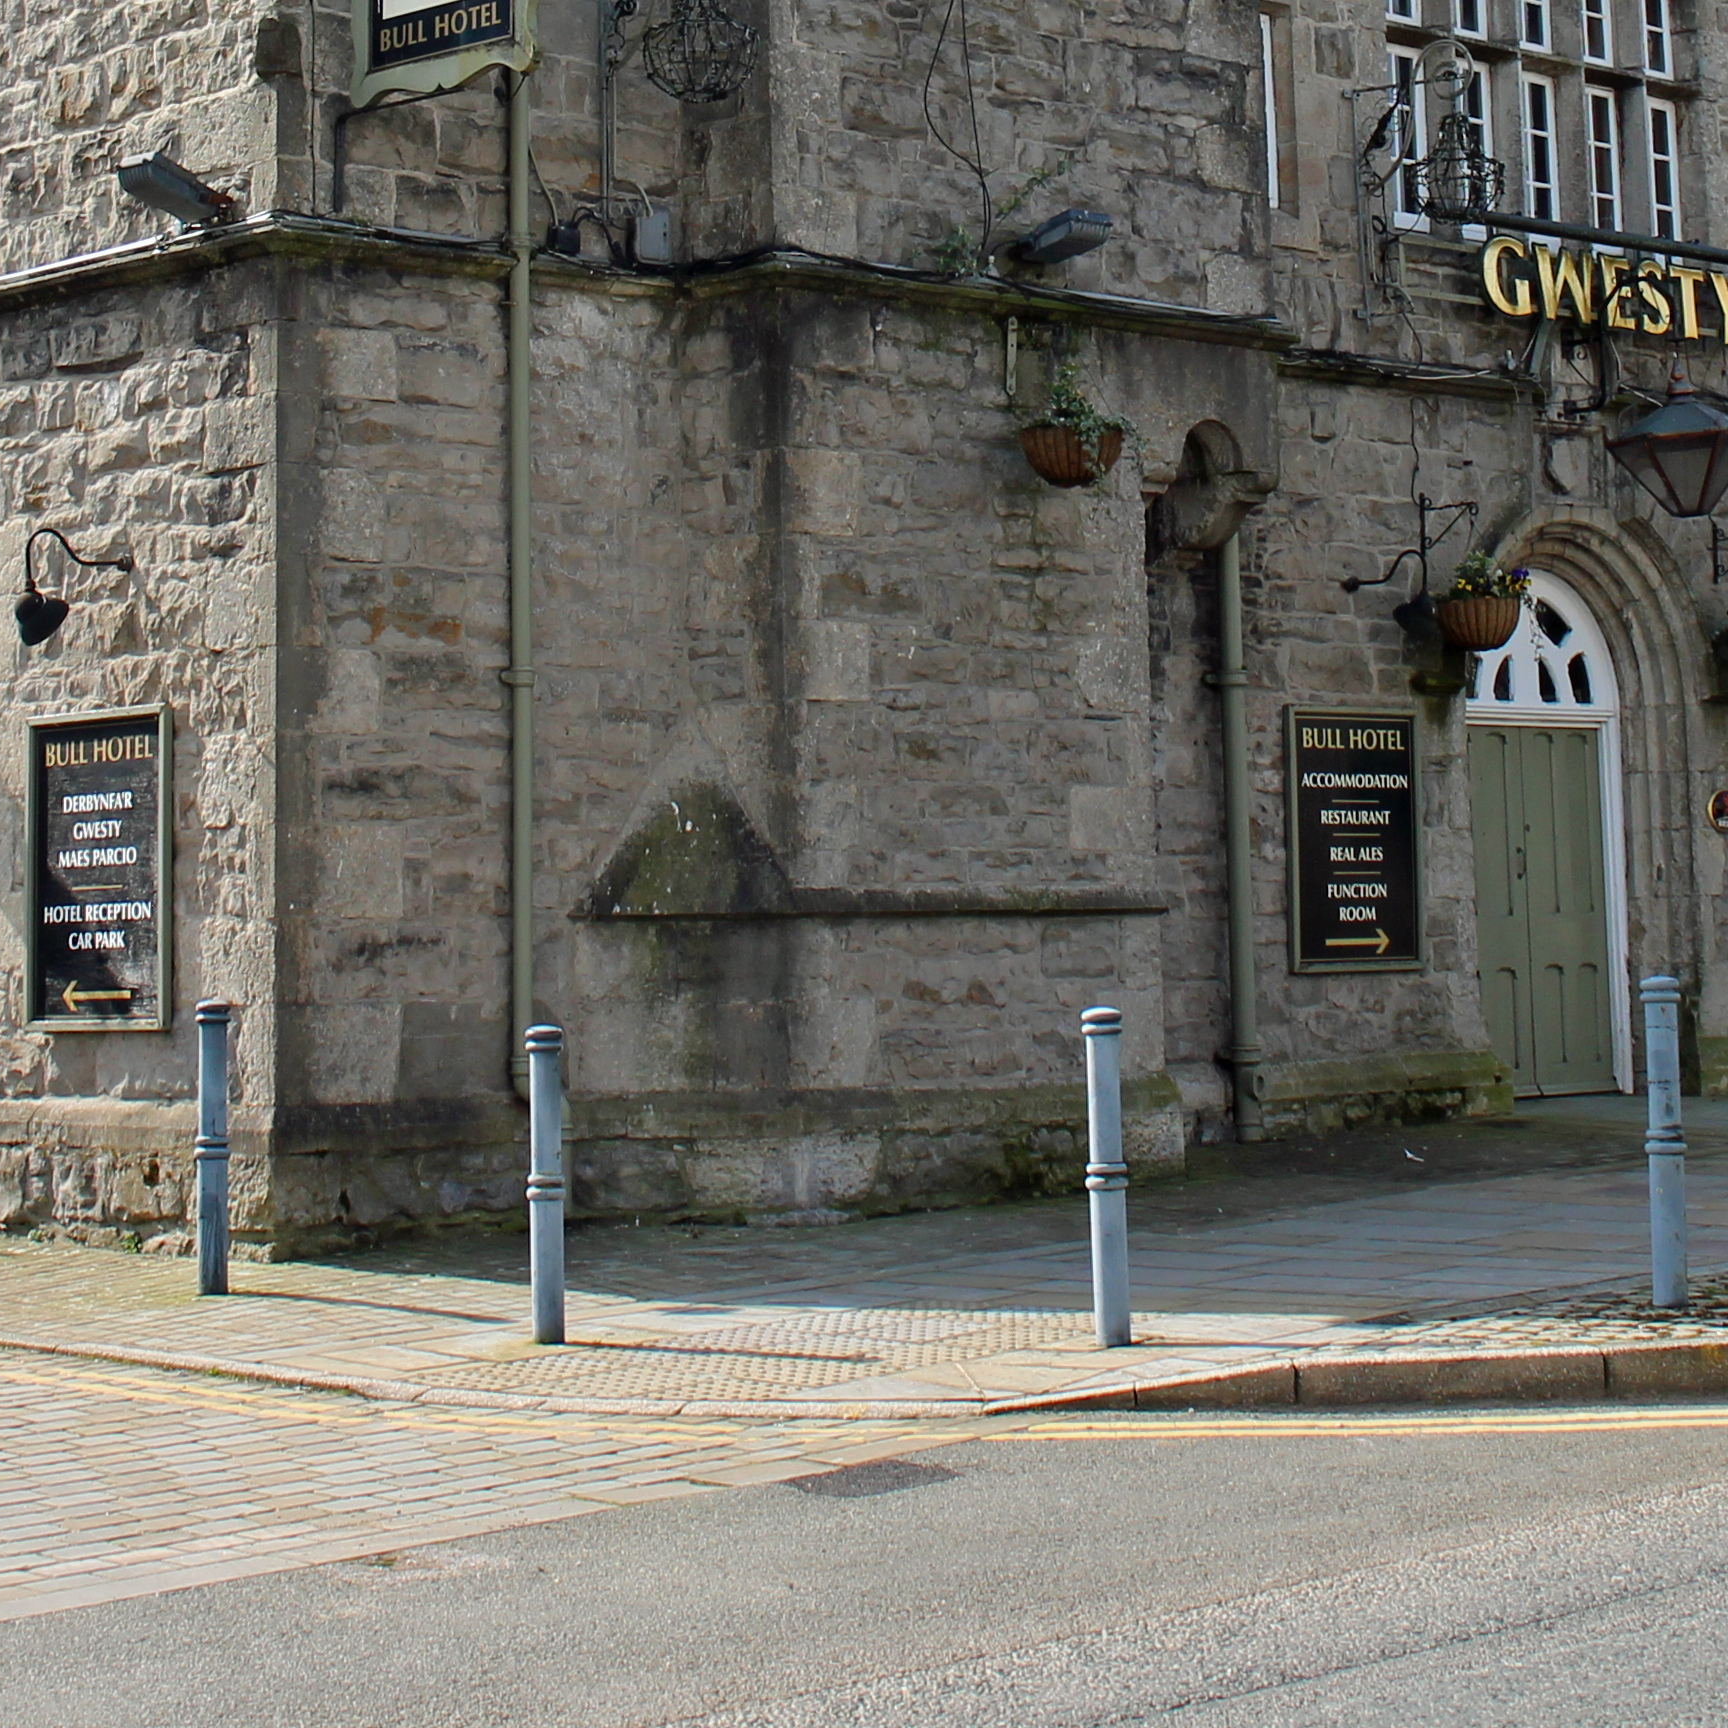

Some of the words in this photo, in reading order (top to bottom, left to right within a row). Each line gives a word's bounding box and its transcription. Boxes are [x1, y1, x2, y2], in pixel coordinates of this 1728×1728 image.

[379, 18, 428, 52] BULL
[434, 2, 502, 42] HOTEL
[45, 740, 88, 767] BULL
[93, 733, 153, 763] HOTEL
[1302, 727, 1345, 750] BULL
[1349, 728, 1405, 751] HOTEL
[1301, 772, 1408, 790] ACCOMMODATION
[62, 790, 133, 814] DERBYNFA'R
[1320, 809, 1391, 826] RESTAURANT
[73, 819, 122, 841] GWESTY
[57, 848, 90, 869] MAES
[92, 845, 137, 867] PARCIO
[1330, 846, 1357, 862] REAL
[1358, 846, 1384, 862] ALES
[1327, 882, 1387, 899] FUNCTION
[43, 904, 83, 925] HOTEL
[85, 900, 152, 922] RECEPTION
[1339, 906, 1377, 922] ROOM
[68, 931, 93, 950] CAR
[95, 929, 125, 949] PARK
